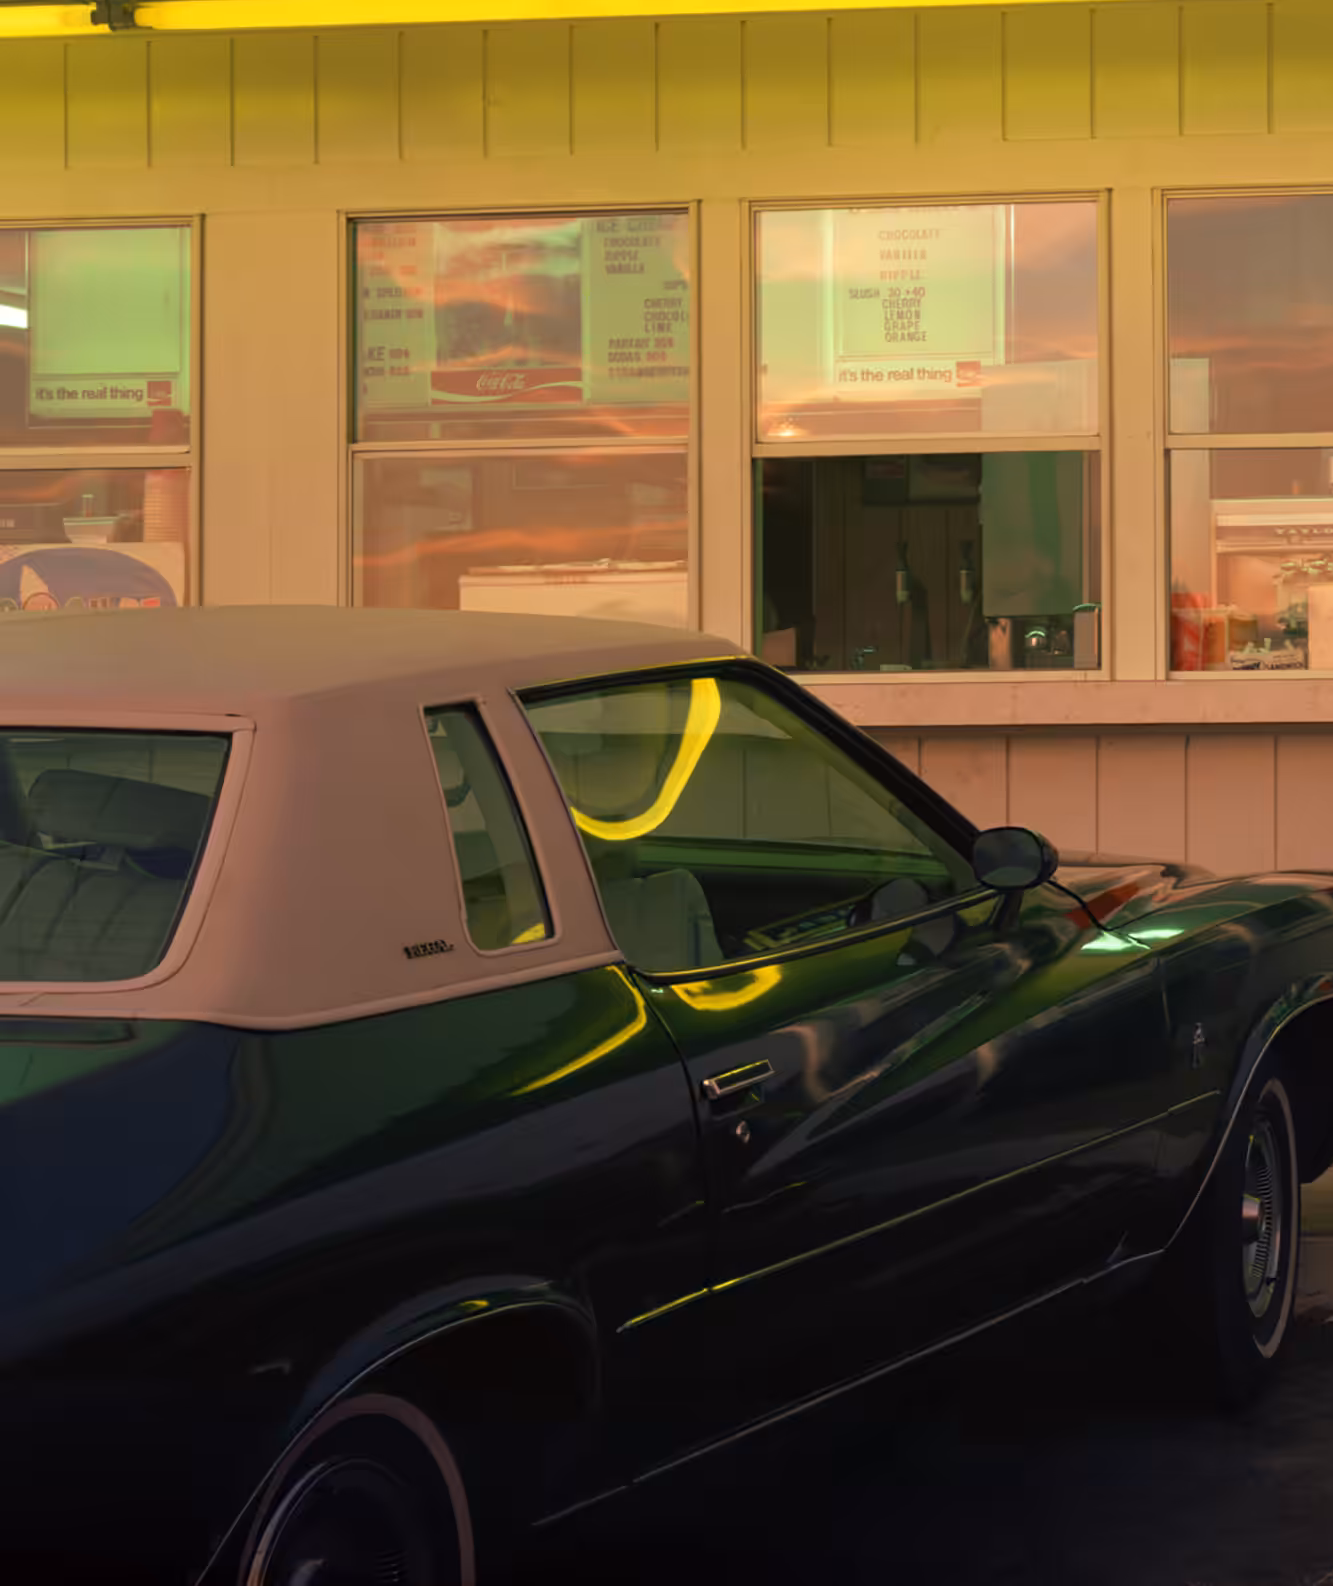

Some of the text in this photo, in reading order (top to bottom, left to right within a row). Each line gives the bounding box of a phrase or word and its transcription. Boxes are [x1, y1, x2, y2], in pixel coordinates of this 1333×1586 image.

[881, 298, 922, 310] CHERRY
[883, 309, 921, 321] LEMON
[883, 320, 921, 332] GRAPE
[884, 331, 928, 343] ORANGE
[860, 368, 884, 382] the
[887, 367, 914, 382] real
[916, 367, 953, 383] thing
[56, 386, 79, 400] the
[81, 386, 108, 401] real
[110, 386, 144, 402] thing
